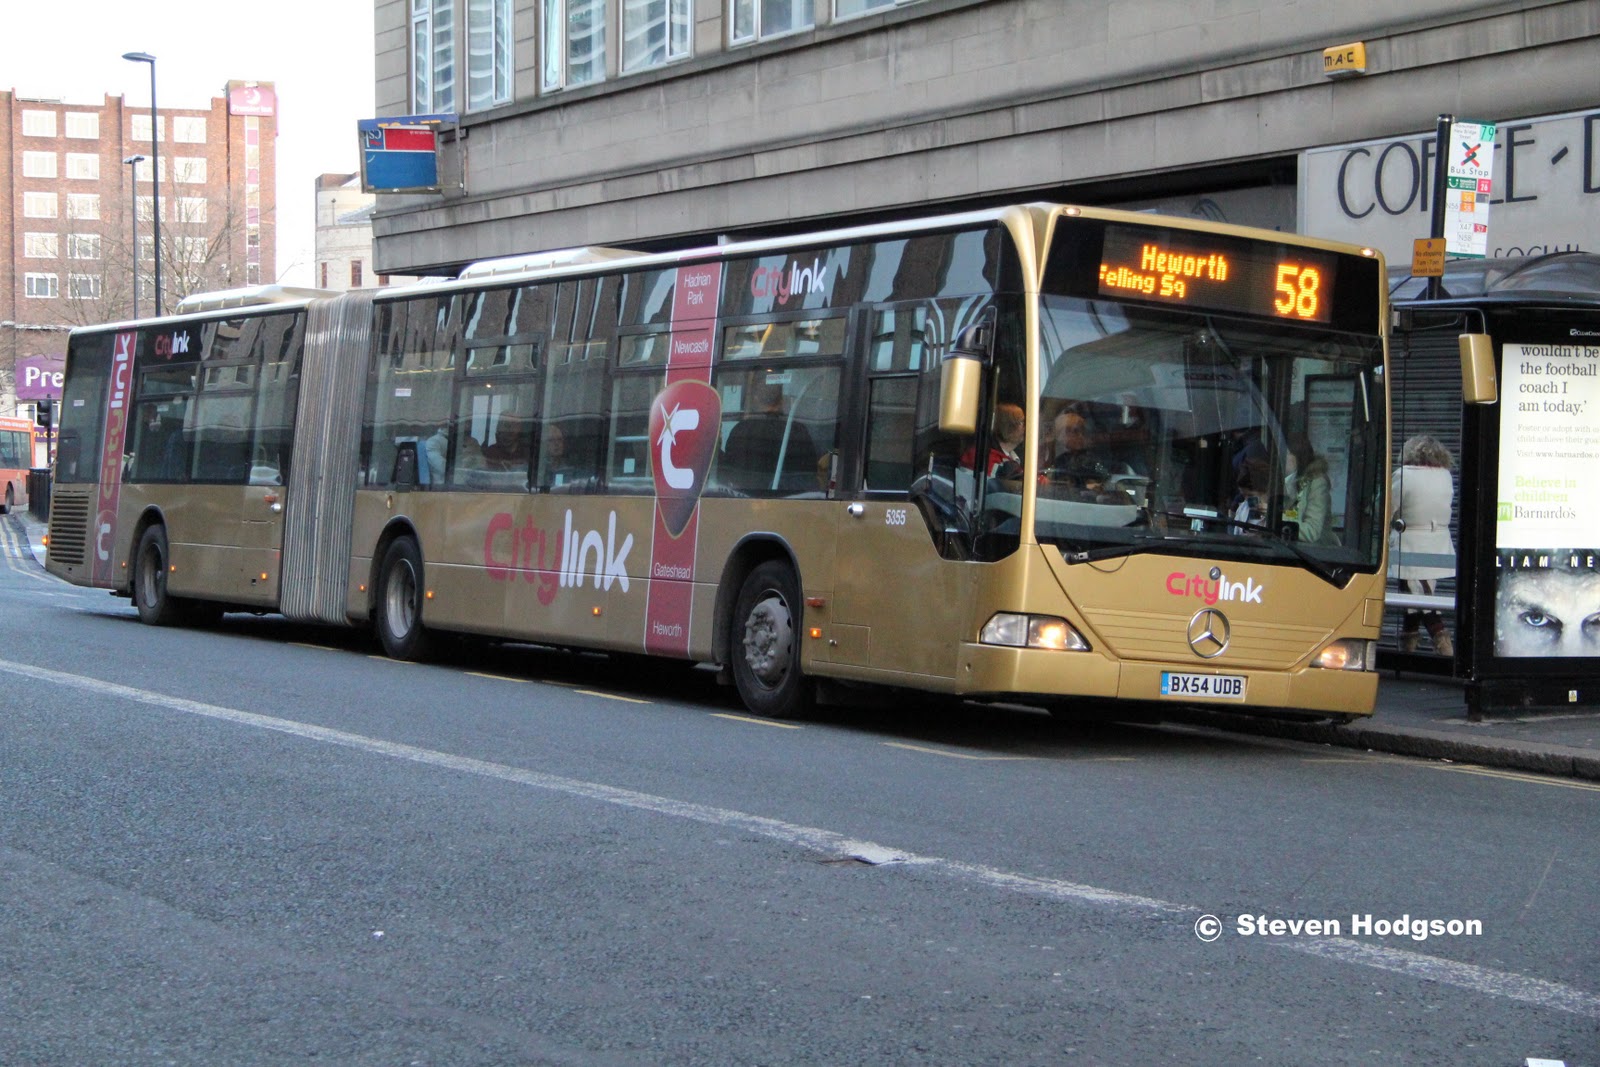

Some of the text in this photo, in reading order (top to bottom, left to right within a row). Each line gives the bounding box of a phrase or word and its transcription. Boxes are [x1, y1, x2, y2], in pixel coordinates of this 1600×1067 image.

[1481, 125, 1495, 141] 79
[1338, 124, 1537, 219] COFE
[1450, 166, 1489, 177] Bus Stop
[1141, 245, 1229, 281] Heworth
[684, 274, 711, 288] Hadrian
[751, 258, 827, 305] Citylink
[687, 291, 704, 305] Park
[1275, 264, 1320, 317] 58
[155, 330, 190, 360] Citylink
[674, 339, 709, 354] Newcastle
[1521, 345, 1599, 358] wouldn't be
[25, 366, 64, 388] Pre
[1520, 362, 1597, 376] the football
[1519, 381, 1568, 394] coach I
[1519, 401, 1540, 412] am
[1515, 475, 1561, 488] Believe
[1514, 490, 1568, 502] children
[886, 509, 906, 525] 5355
[1514, 505, 1576, 519] Barnardo's
[484, 508, 634, 606] Citylink
[1496, 555, 1549, 567] LIAM
[653, 562, 692, 579] Gateshead
[1166, 572, 1263, 605] Citylink
[652, 620, 683, 637] Heworth
[1171, 676, 1242, 695] BX54 UDB
